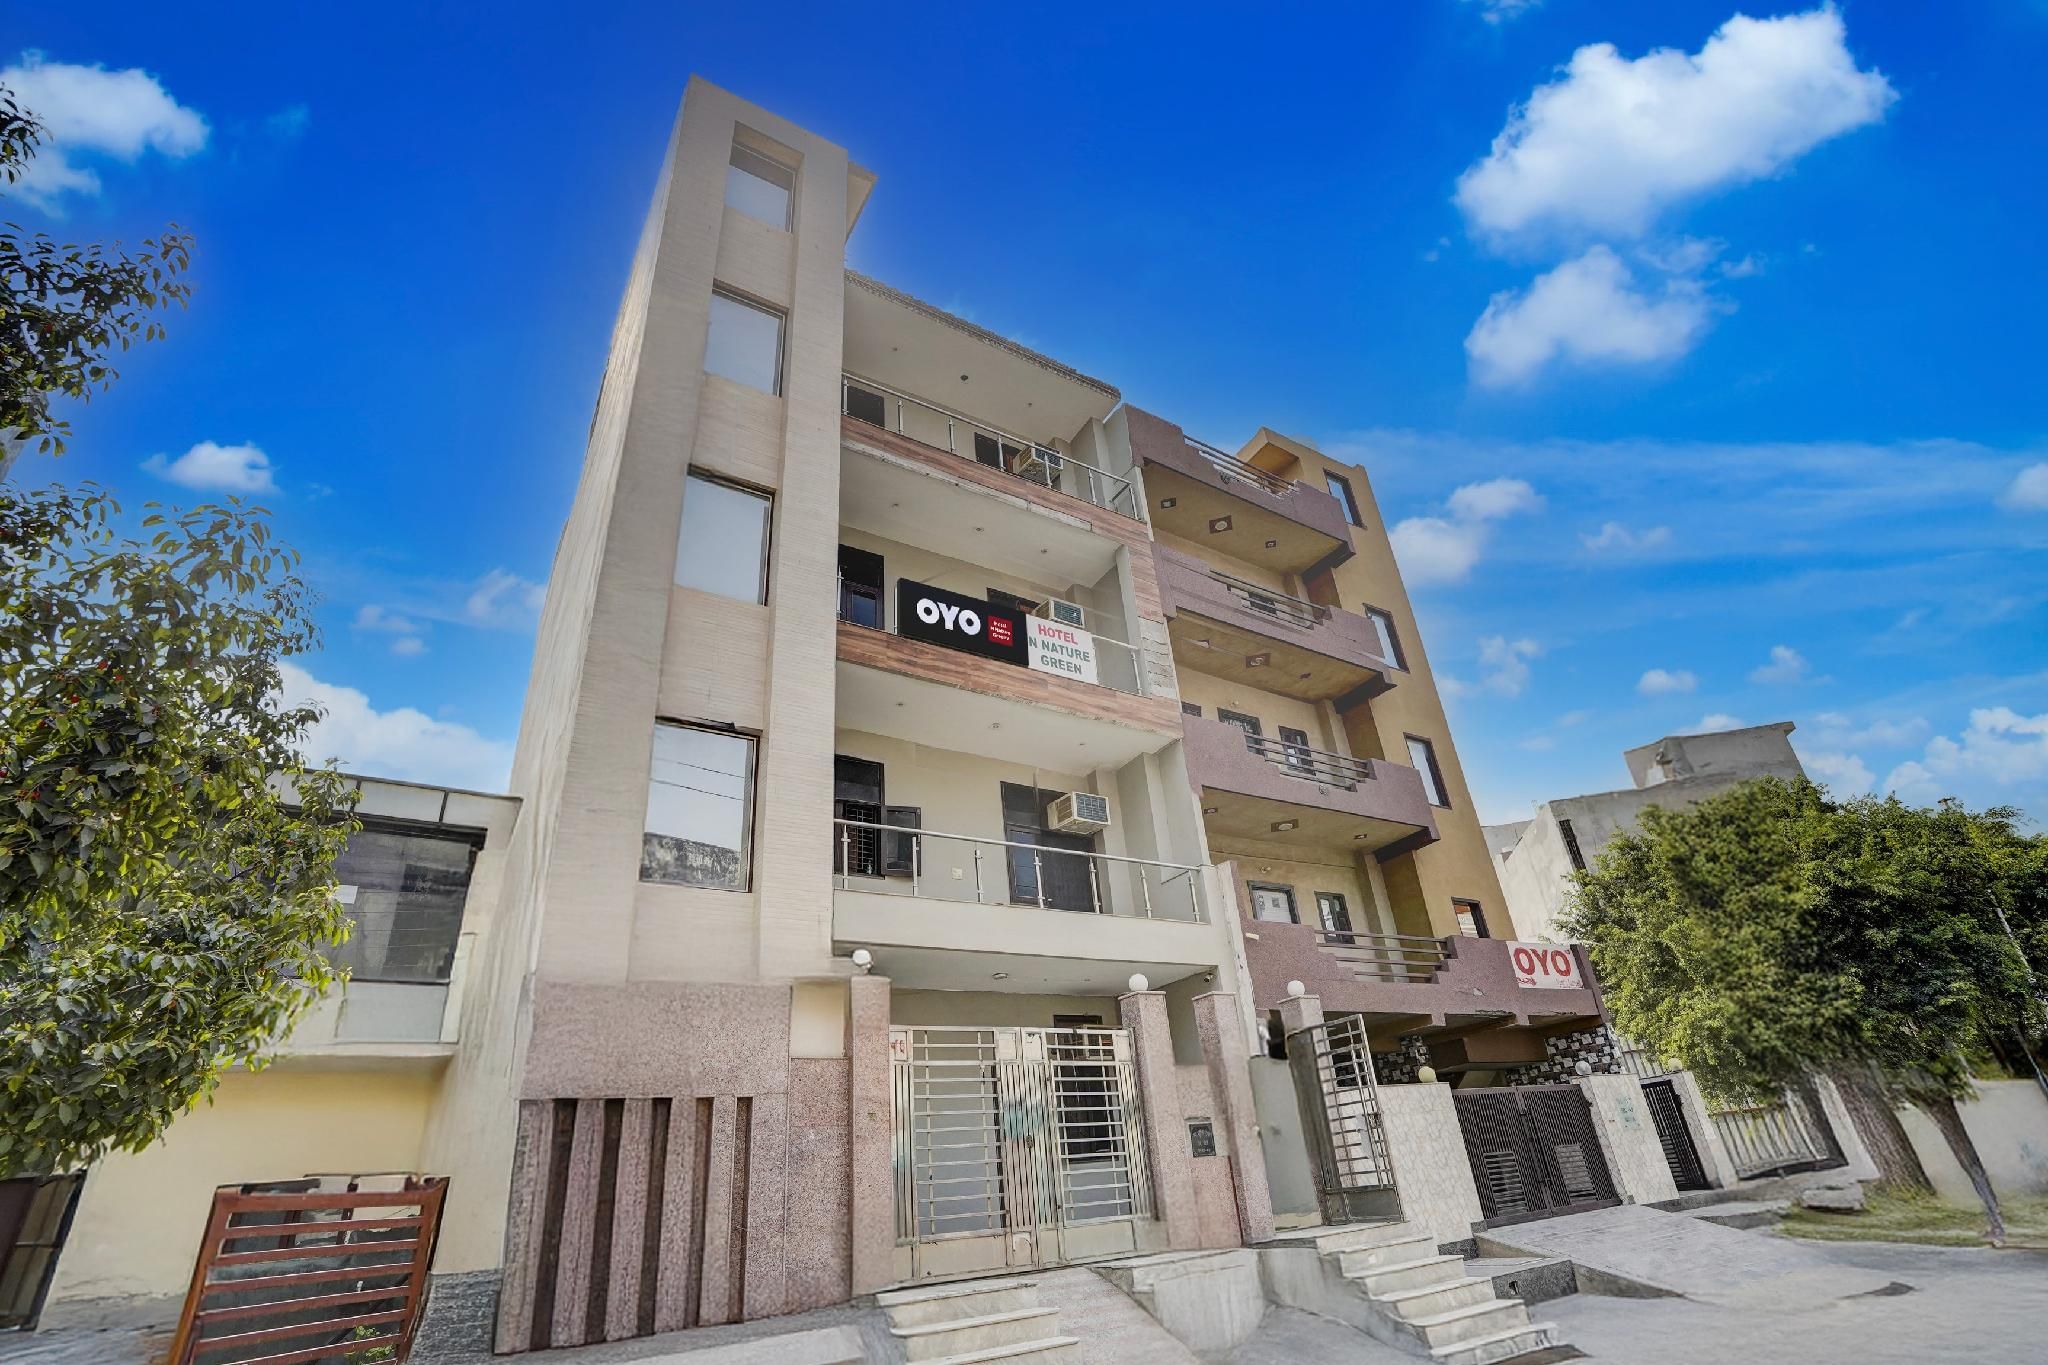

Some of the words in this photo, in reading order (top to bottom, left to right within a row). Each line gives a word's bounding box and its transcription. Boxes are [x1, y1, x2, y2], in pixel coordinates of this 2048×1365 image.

[916, 598, 981, 636] OYO
[1038, 624, 1078, 645] HOTEL
[1028, 636, 1038, 648] N
[1041, 640, 1090, 662] NATURE
[1040, 655, 1082, 675] GREEN
[1513, 947, 1571, 976] OYO
